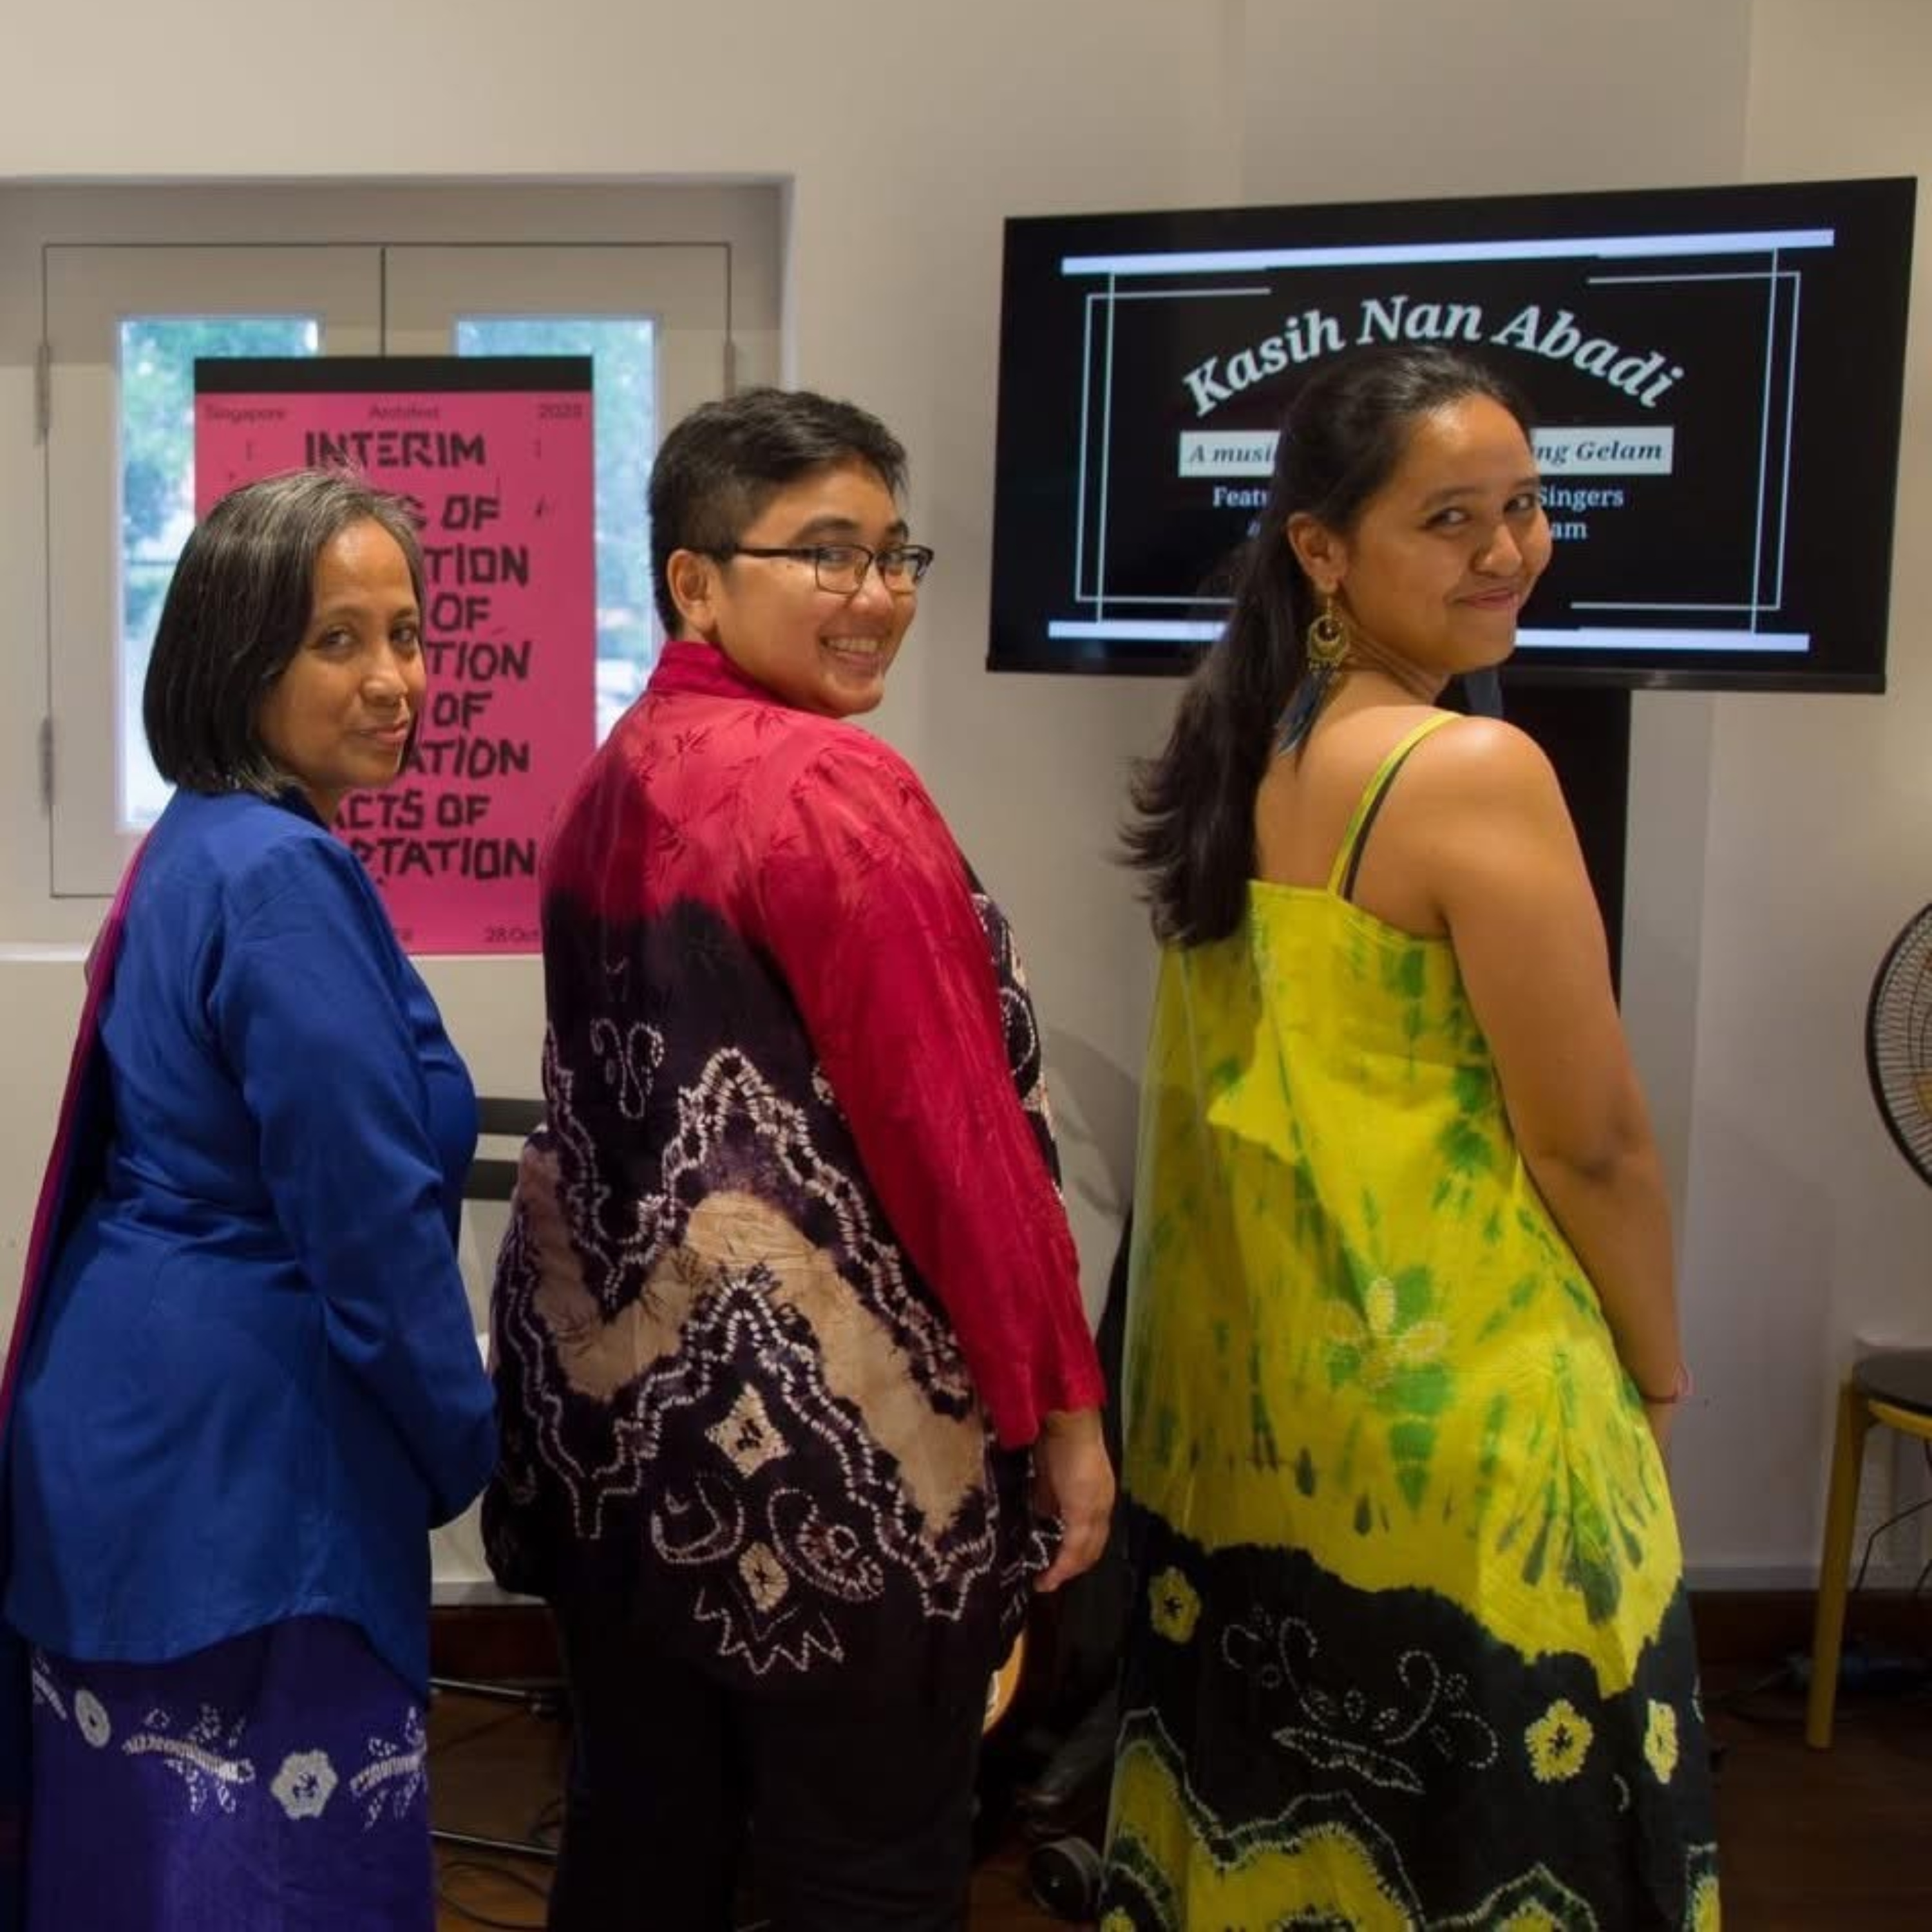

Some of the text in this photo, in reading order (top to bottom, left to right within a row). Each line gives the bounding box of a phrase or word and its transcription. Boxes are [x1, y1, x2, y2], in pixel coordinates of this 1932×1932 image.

[1182, 295, 1684, 417] Kasih Nan Abadi
[305, 431, 487, 469] INTERIM
[1189, 444, 1204, 462] A
[1212, 442, 1273, 462] musi
[1575, 439, 1662, 461] Gelam
[441, 493, 500, 532] OF
[430, 591, 491, 633] OF
[431, 690, 493, 731] OF
[436, 792, 492, 829] OF
